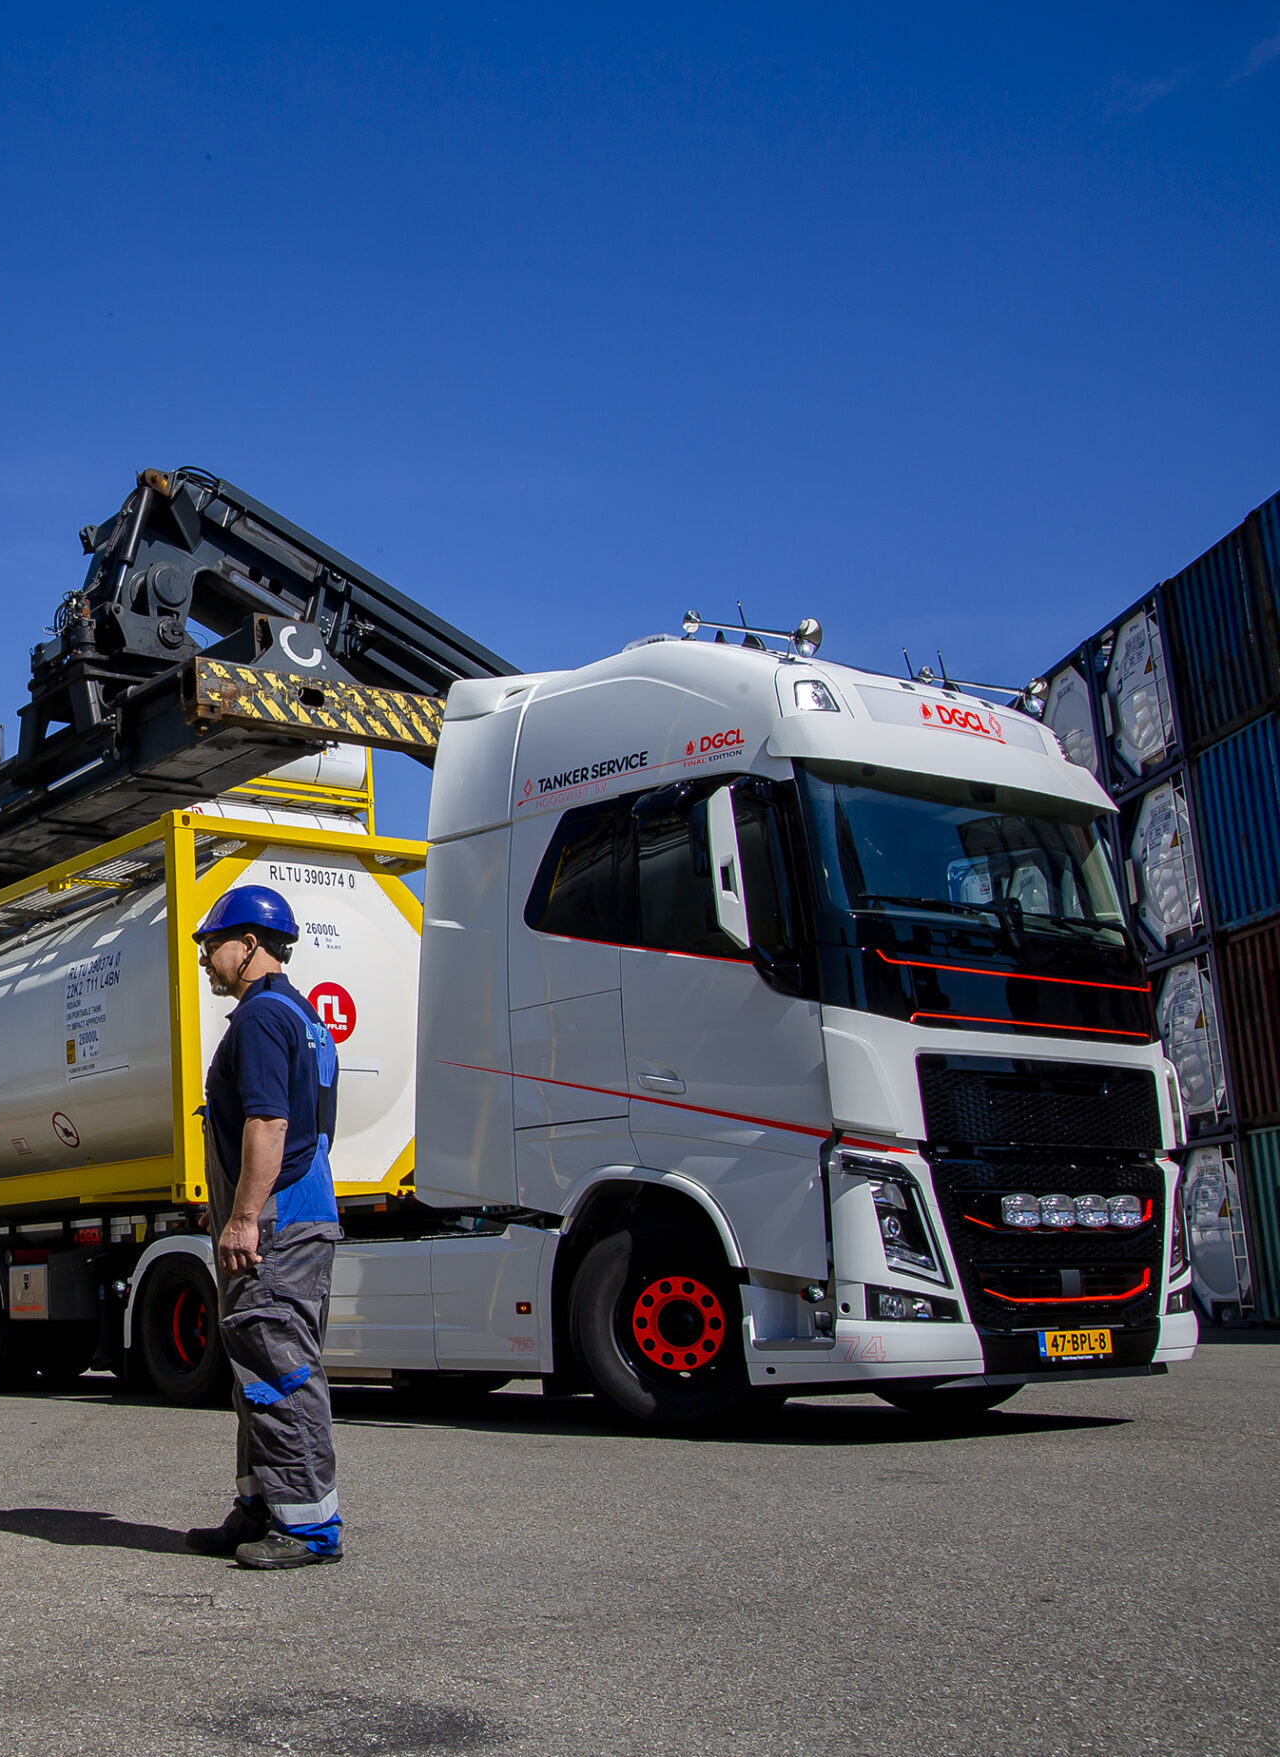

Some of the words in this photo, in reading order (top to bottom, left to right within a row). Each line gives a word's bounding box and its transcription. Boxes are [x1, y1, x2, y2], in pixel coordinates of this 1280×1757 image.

[935, 704, 991, 735] DGCL
[699, 728, 745, 753] DGCL
[683, 758, 707, 768] FINAL
[708, 749, 743, 762] EDITION
[537, 766, 589, 794] TANKER
[591, 751, 648, 779] SERVICE
[535, 787, 589, 809] HOOGVLIET
[269, 865, 301, 882] RLTU
[304, 869, 345, 887] 390374
[348, 873, 355, 889] 0
[305, 922, 340, 936] 26000L
[313, 936, 320, 948] 4
[67, 980, 83, 999] 22K2
[86, 976, 99, 993] T11
[100, 969, 120, 989] L4BN
[68, 965, 88, 981] RLTU
[837, 1335, 887, 1362] 74
[1051, 1332, 1107, 1352] 47-BPL-8
